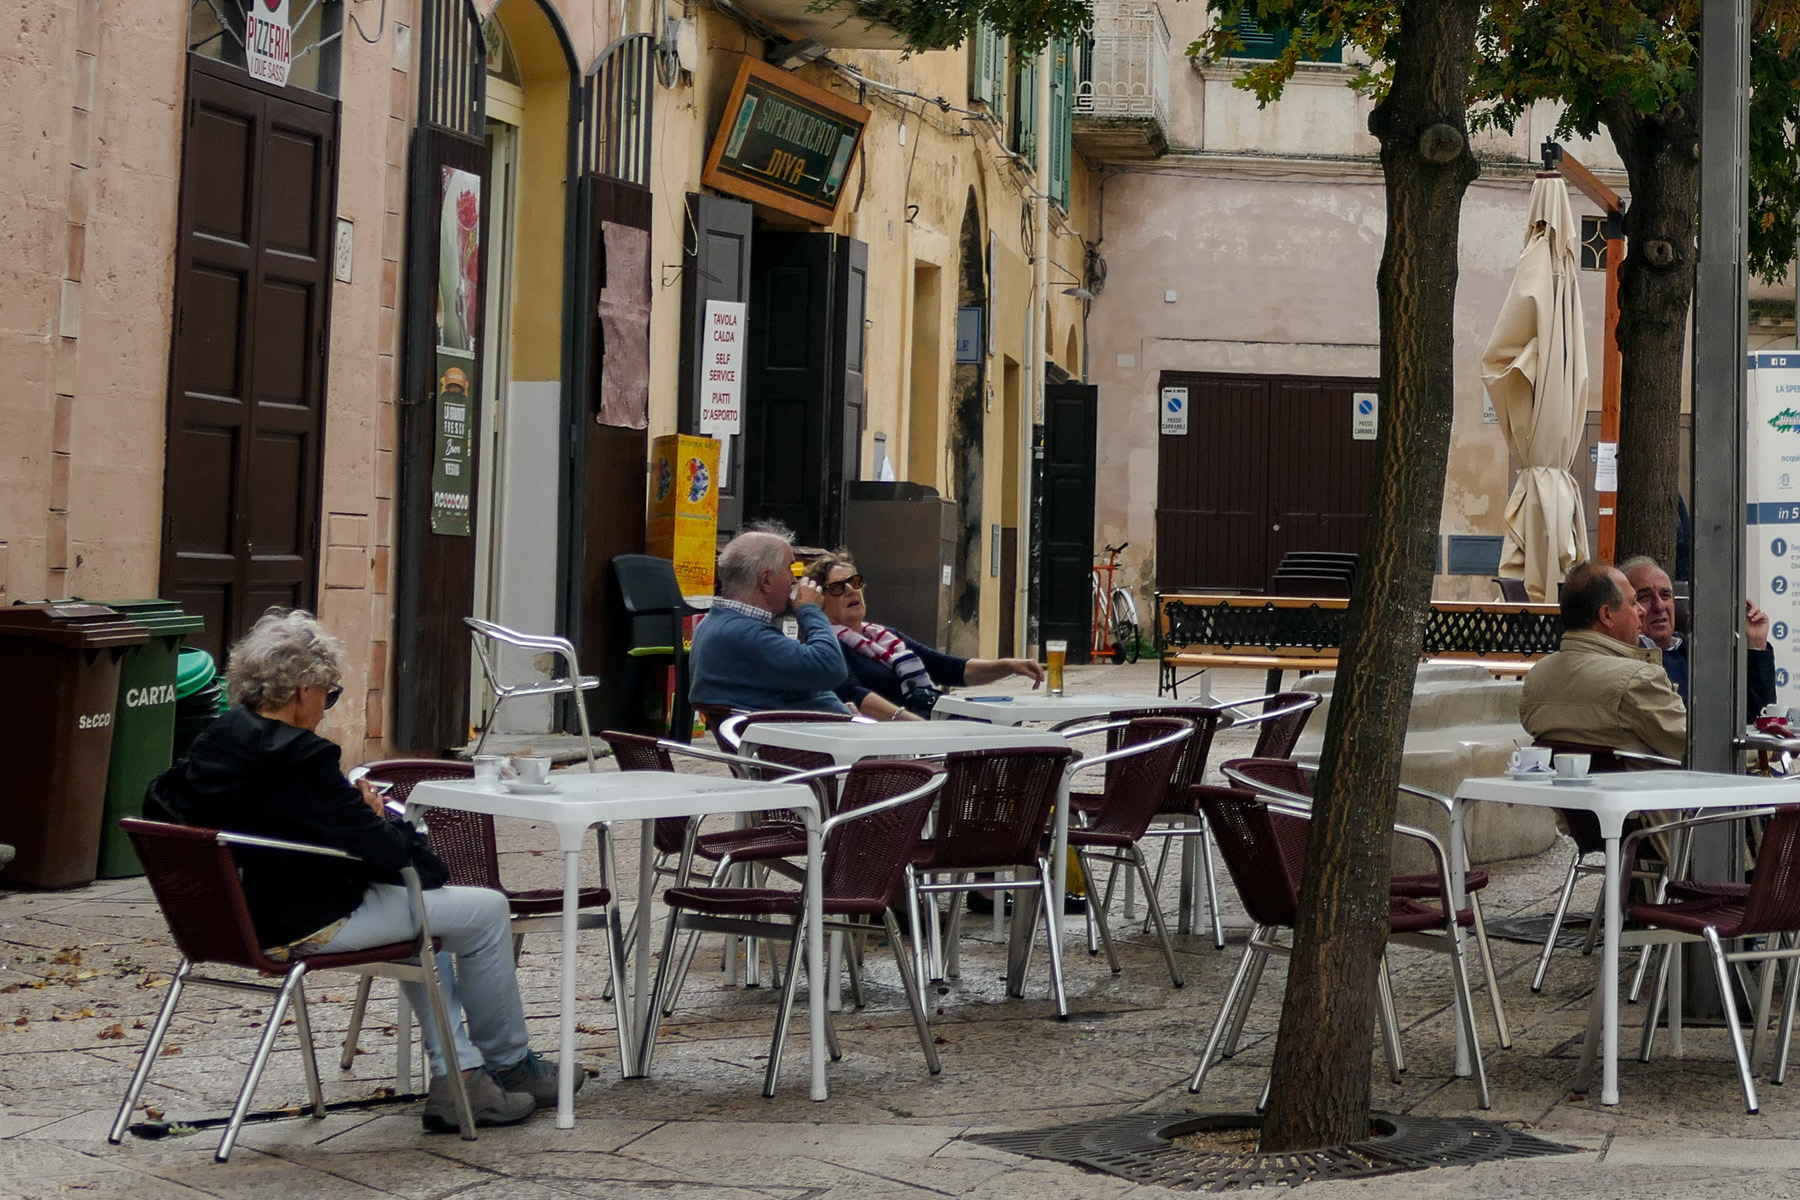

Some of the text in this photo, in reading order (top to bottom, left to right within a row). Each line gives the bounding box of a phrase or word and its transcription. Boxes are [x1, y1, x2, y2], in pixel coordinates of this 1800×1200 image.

[247, 15, 290, 65] PIZZERIA
[255, 58, 267, 77] DUE
[268, 62, 285, 83] SASSI
[757, 98, 838, 157] SUPERMERCATO
[766, 149, 806, 185] DIVA
[713, 313, 737, 326] TAVOLA
[713, 330, 735, 342] CALDA
[715, 353, 731, 365] SELF
[709, 370, 735, 382] SERVICE
[1776, 385, 1784, 393] LA
[712, 393, 730, 404] PIATTI
[703, 409, 738, 421] D'ASPORTO
[1778, 507, 1789, 519] in
[1792, 507, 1800, 519] 5
[126, 684, 176, 708] CARTA
[78, 712, 111, 730] SECCO
